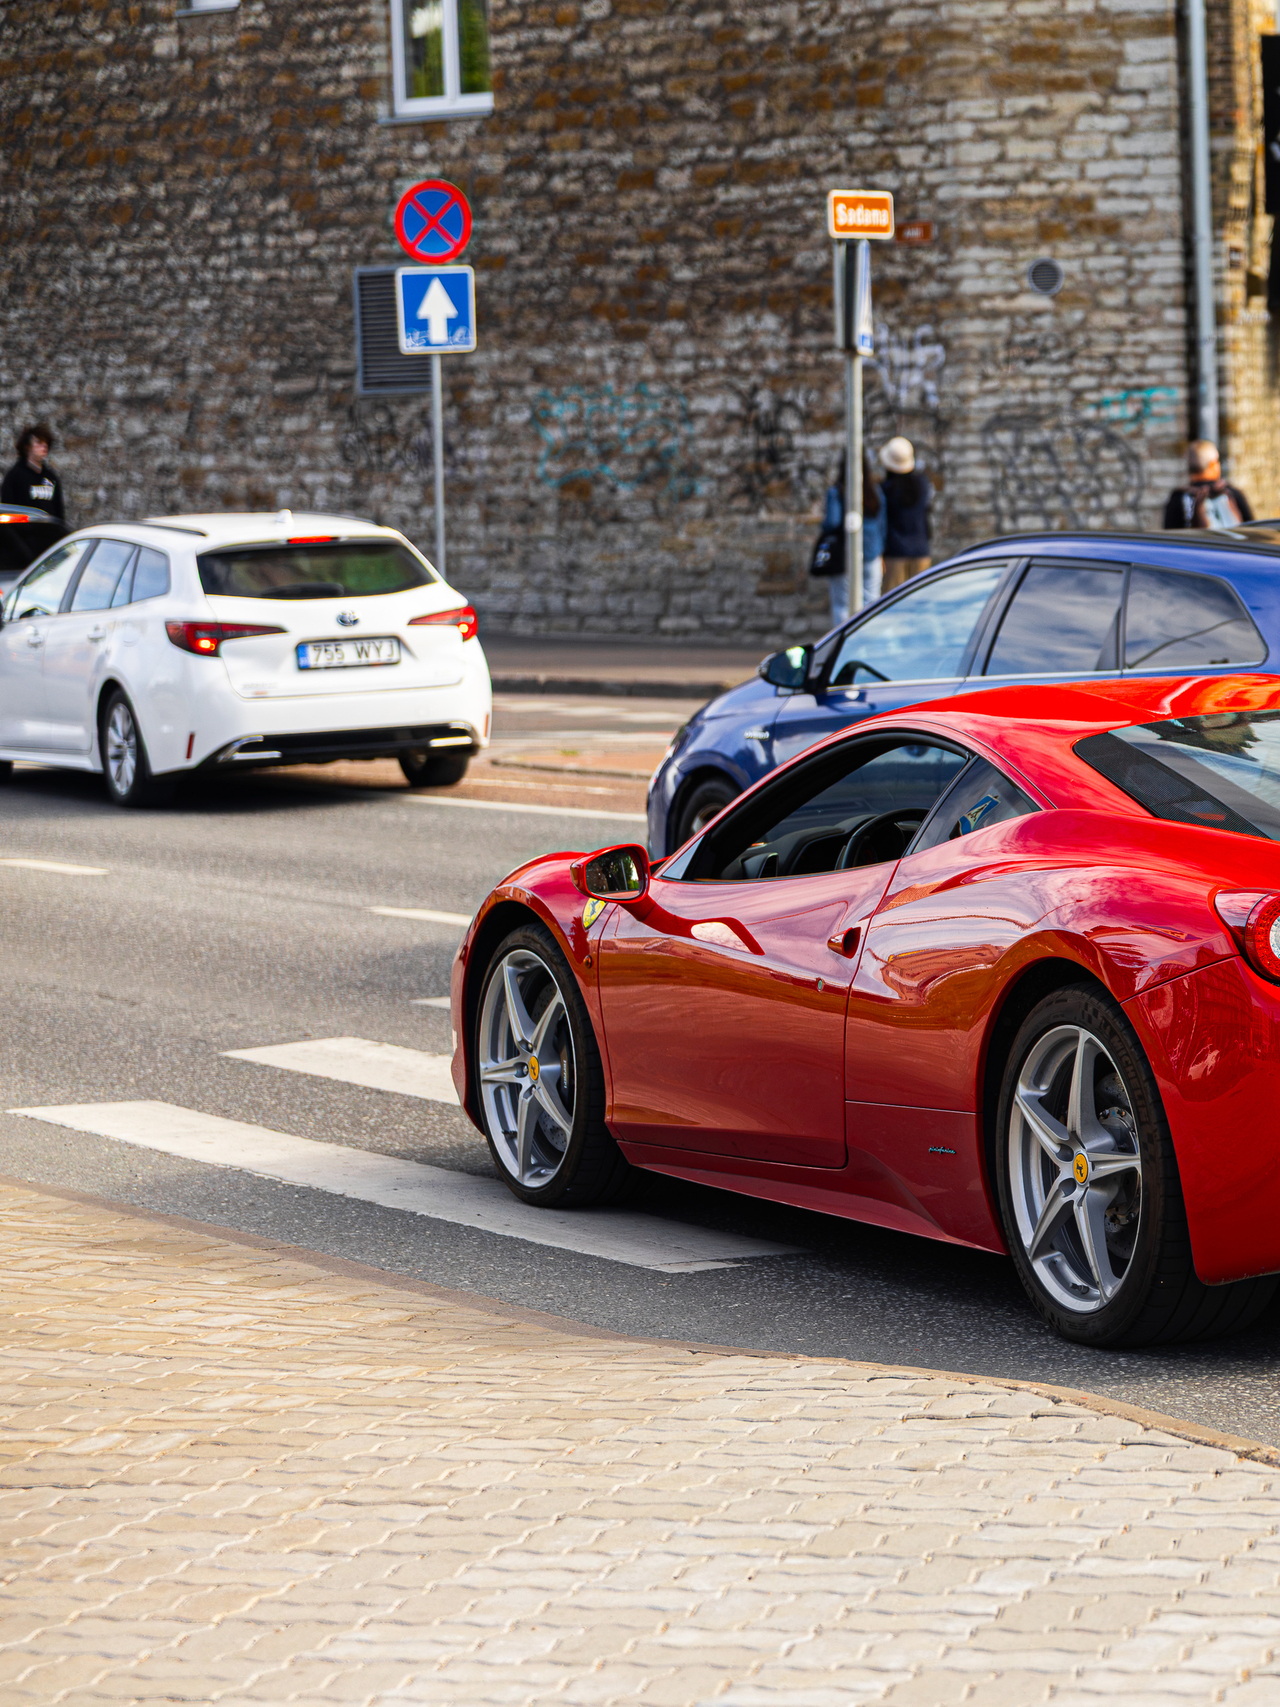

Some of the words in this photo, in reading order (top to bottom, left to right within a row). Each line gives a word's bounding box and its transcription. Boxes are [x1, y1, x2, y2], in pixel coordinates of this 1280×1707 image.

[836, 203, 888, 227] Sadama
[312, 644, 345, 662] 755
[354, 641, 394, 659] WYJ
[1110, 1035, 1150, 1123] MICHELIN
